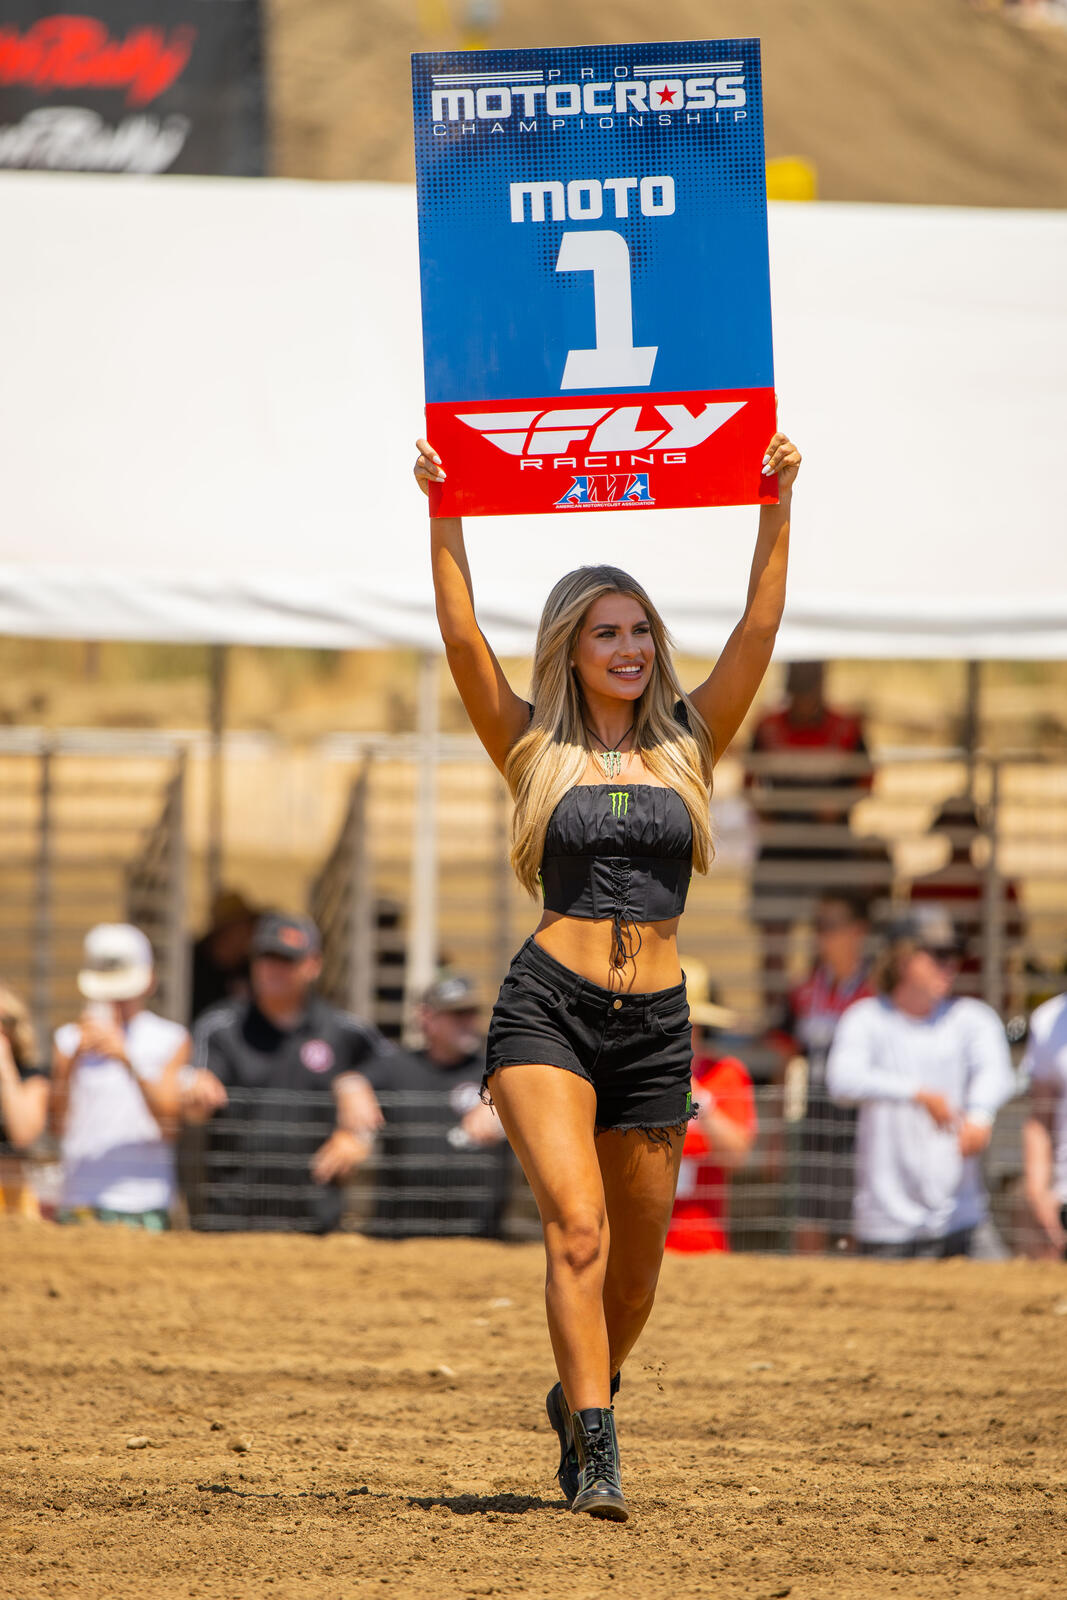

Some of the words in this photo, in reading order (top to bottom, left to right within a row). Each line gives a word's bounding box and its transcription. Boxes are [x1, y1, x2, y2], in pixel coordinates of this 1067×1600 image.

[548, 66, 628, 80] PRO
[431, 76, 746, 121] MOTOCROSS
[433, 110, 747, 136] CHAMPIONSHIP
[509, 175, 676, 223] MOTO
[555, 229, 659, 390] 1
[454, 401, 749, 456] FLY
[520, 452, 687, 470] RACING
[552, 472, 657, 505] AMA
